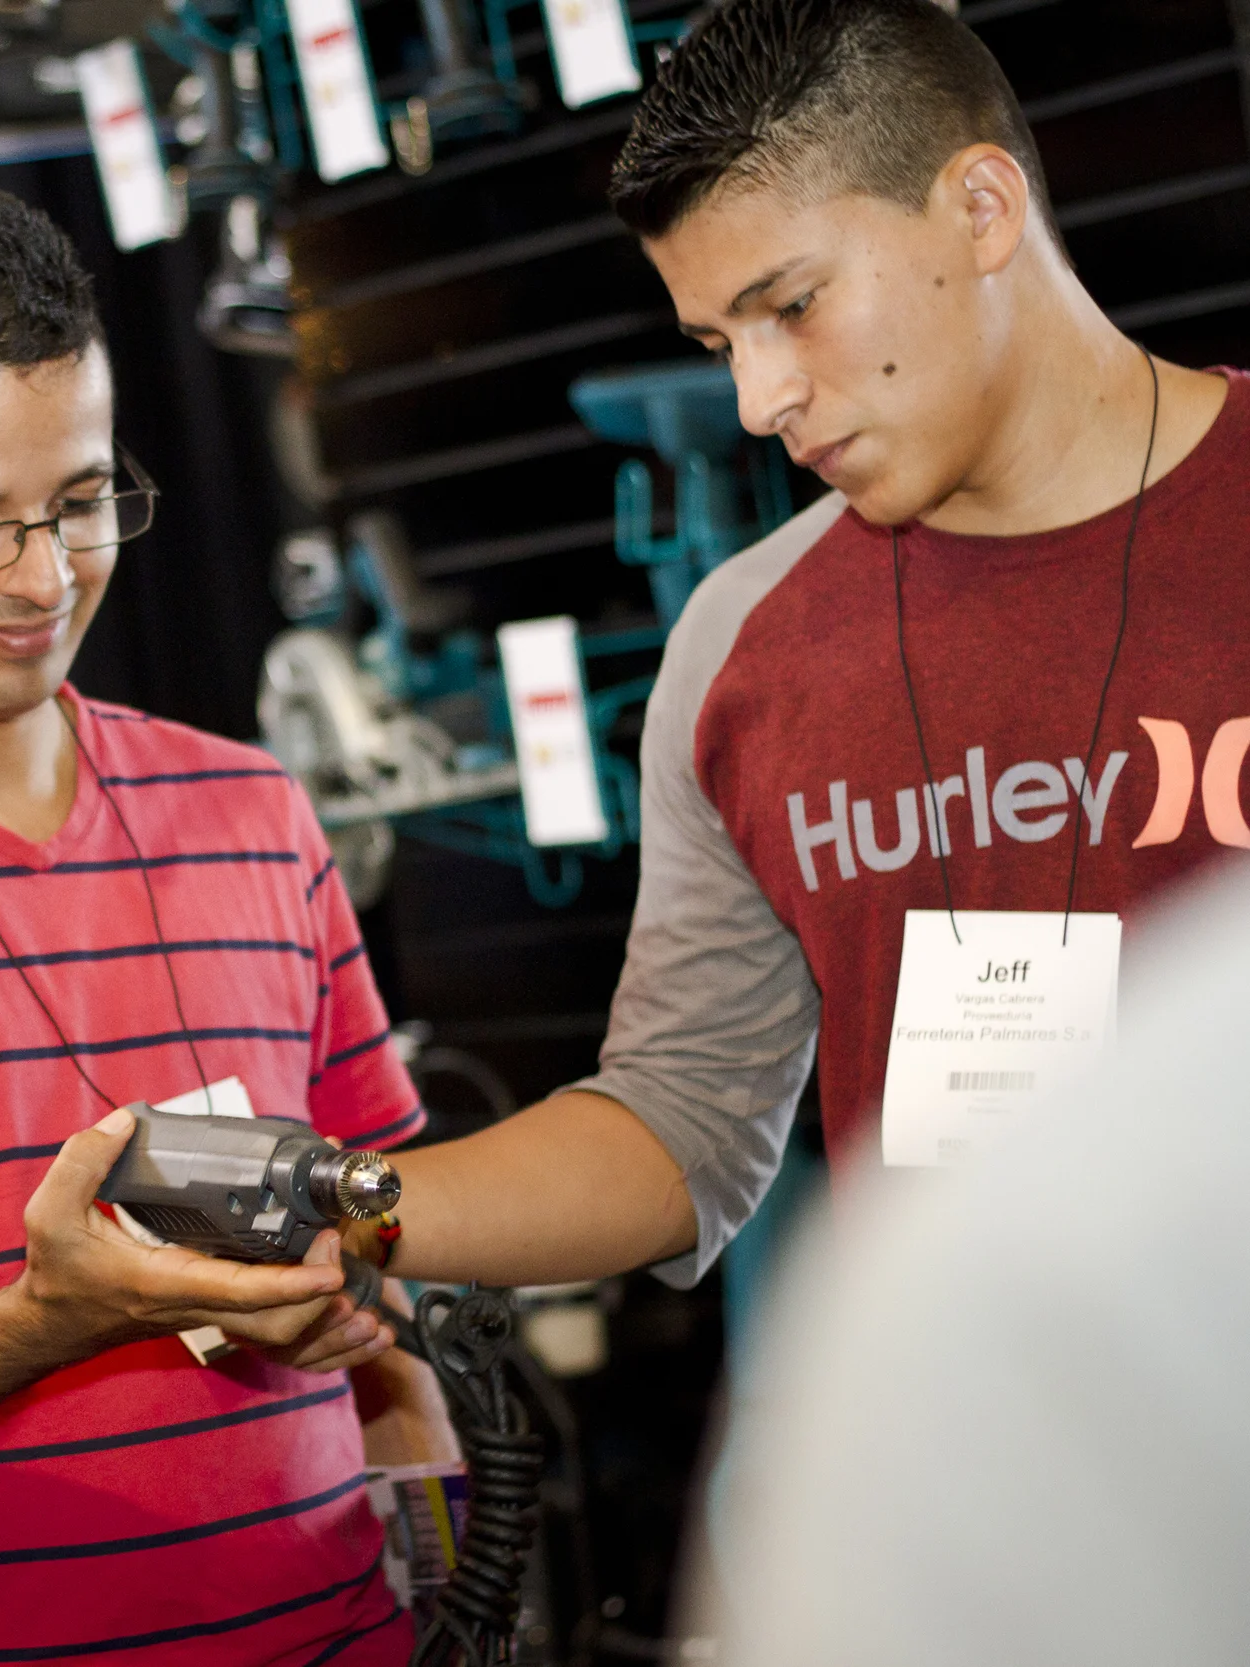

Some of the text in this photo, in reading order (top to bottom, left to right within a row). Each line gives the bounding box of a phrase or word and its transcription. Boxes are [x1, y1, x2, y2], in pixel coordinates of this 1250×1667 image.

[786, 745, 1130, 893] Hurley
[977, 960, 1031, 983] Jeff
[955, 993, 1045, 1006] Vargas Cabrera
[979, 1026, 1057, 1042] Palmares
